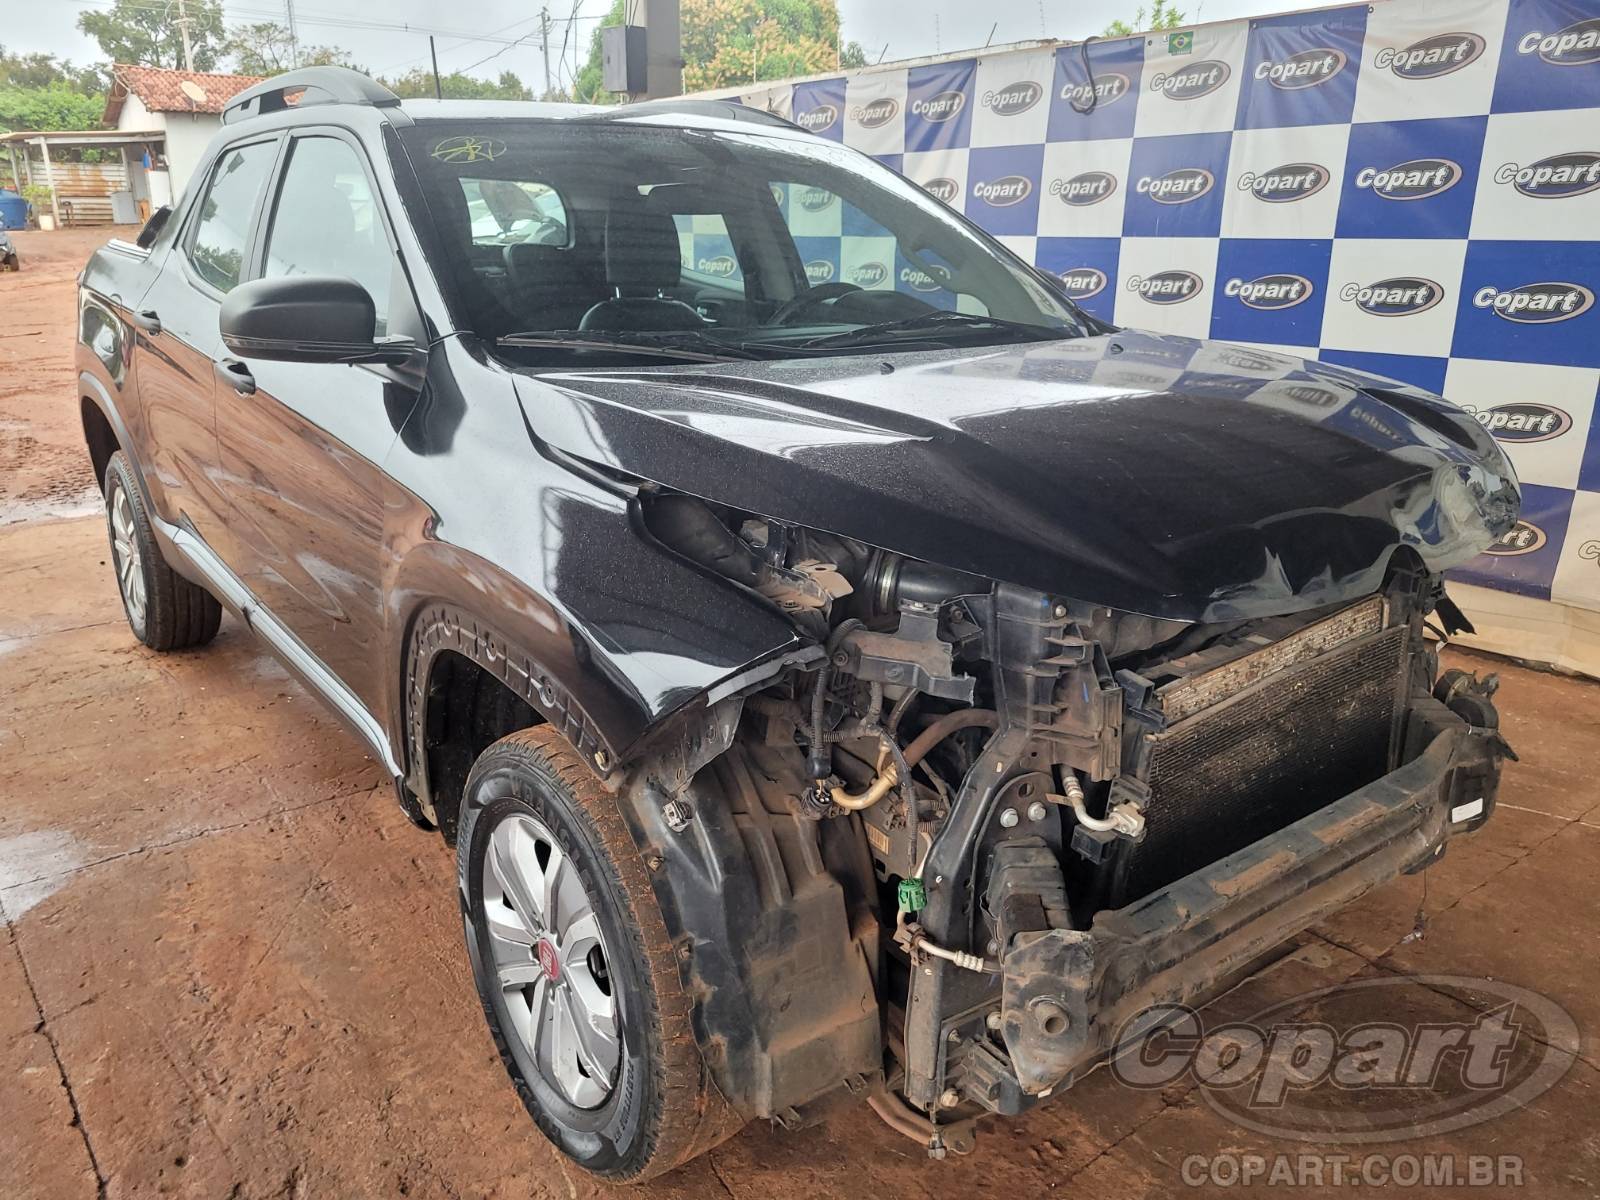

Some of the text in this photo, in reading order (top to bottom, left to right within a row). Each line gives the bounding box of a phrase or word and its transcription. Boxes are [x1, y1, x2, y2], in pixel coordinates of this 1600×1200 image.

[1517, 30, 1600, 58] Copa
[1374, 40, 1471, 71] Copart
[1150, 66, 1219, 92] Copart
[1254, 56, 1334, 81] Copart
[982, 87, 1033, 107] Copart
[1060, 79, 1121, 100] Copart
[850, 104, 893, 121] Copart
[912, 97, 959, 115] Copart
[797, 110, 833, 126] Copart
[1049, 176, 1107, 196] Copart
[1136, 173, 1205, 195] Copart
[1237, 170, 1317, 195] Copart
[1355, 164, 1450, 192] Copart
[973, 181, 1024, 200] Copart
[805, 266, 829, 278] part
[1126, 275, 1195, 295] Copart
[1224, 278, 1300, 301] Copart
[1340, 282, 1430, 307] Copart
[1473, 287, 1581, 314] Copart
